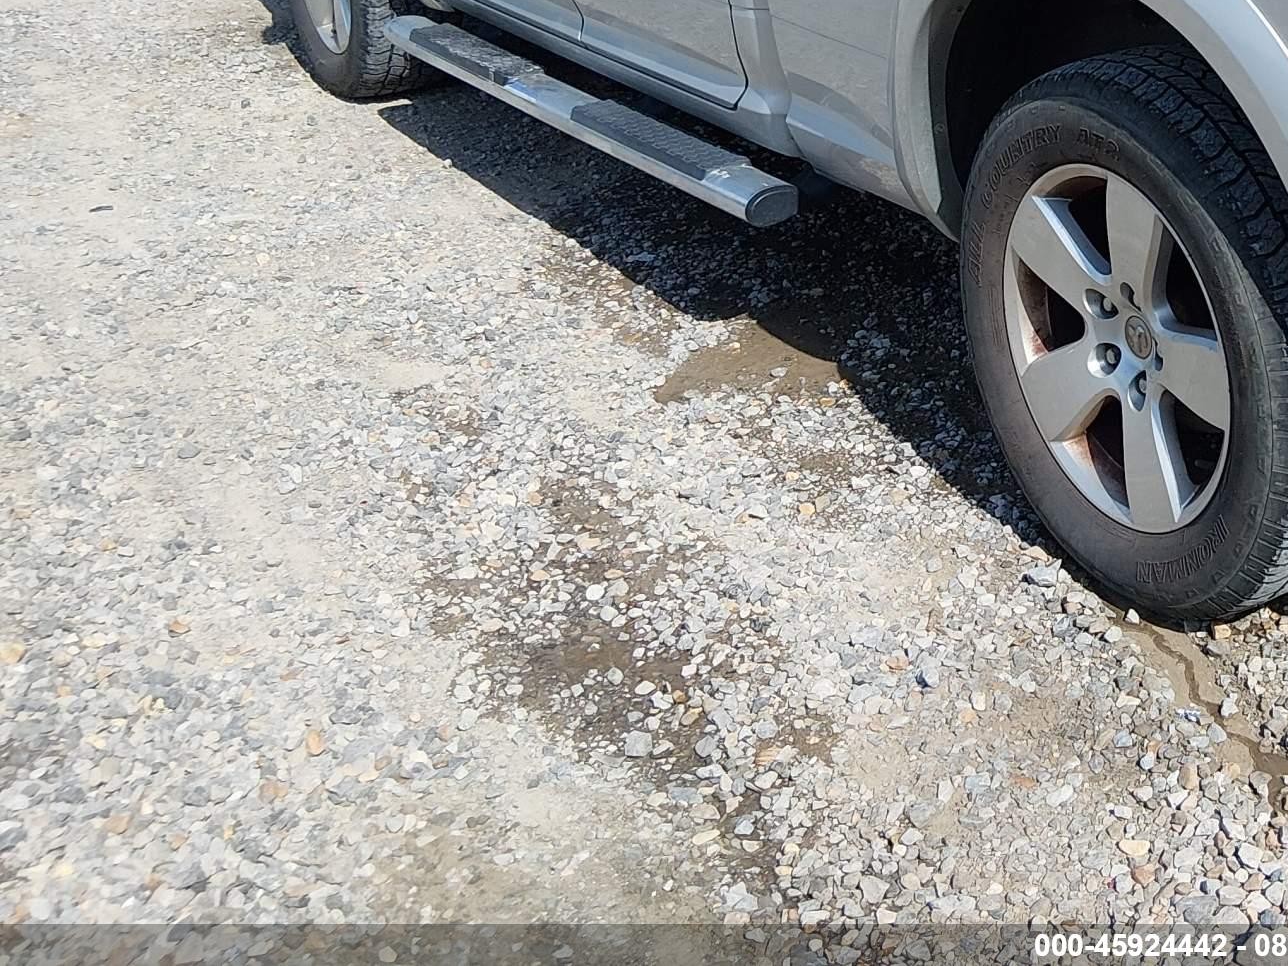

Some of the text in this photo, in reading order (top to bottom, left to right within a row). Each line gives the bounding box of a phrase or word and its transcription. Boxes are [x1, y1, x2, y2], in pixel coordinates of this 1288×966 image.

[967, 220, 988, 288] ALL
[981, 125, 1064, 211] COUNTRY
[1135, 513, 1231, 585] IRONMAN
